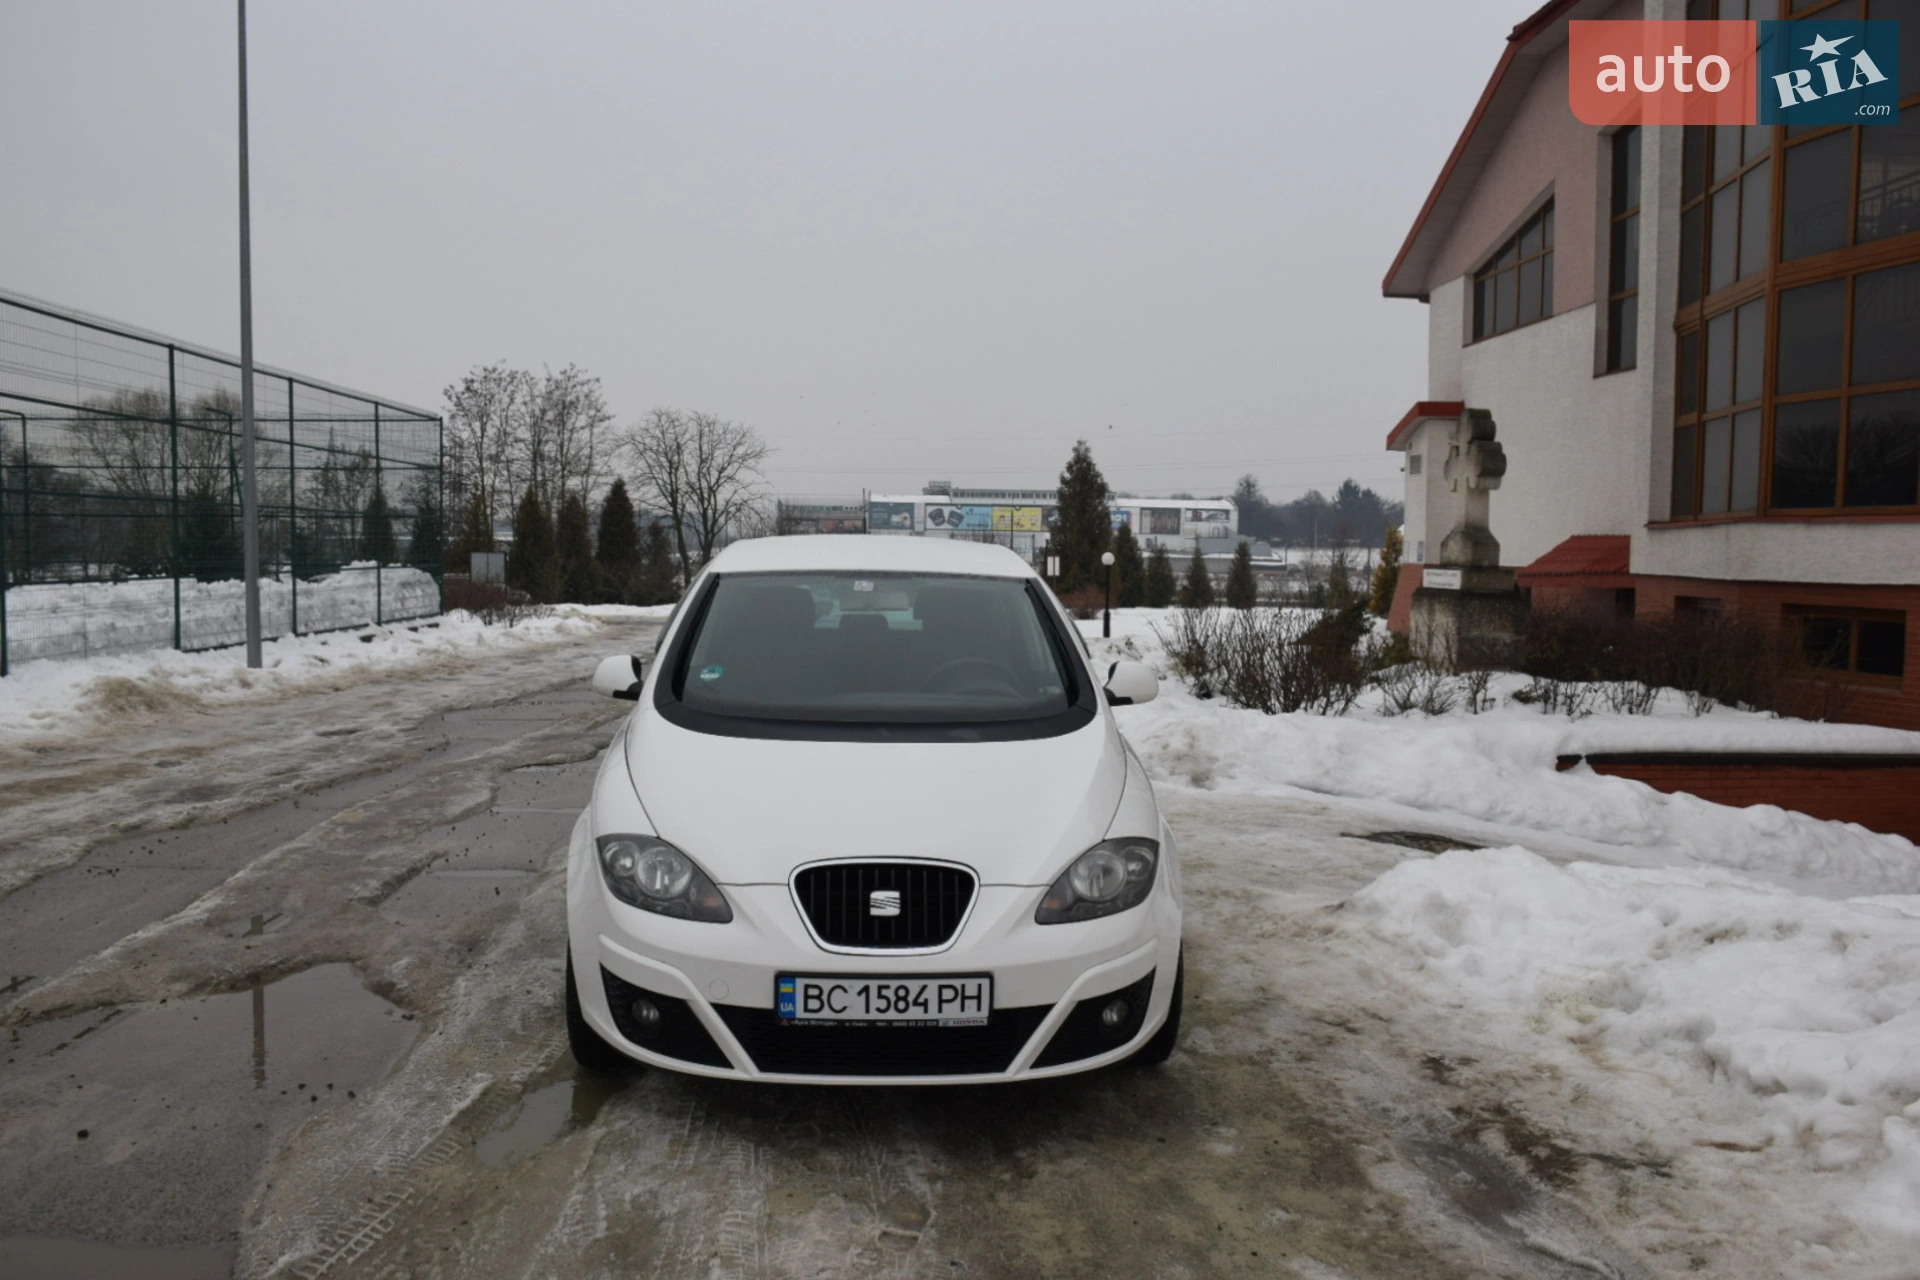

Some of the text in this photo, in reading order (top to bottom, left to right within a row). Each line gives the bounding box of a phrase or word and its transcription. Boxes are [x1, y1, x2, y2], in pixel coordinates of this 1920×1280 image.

[780, 1003, 795, 1012] UA
[803, 983, 983, 1014] BC 1584 PH
